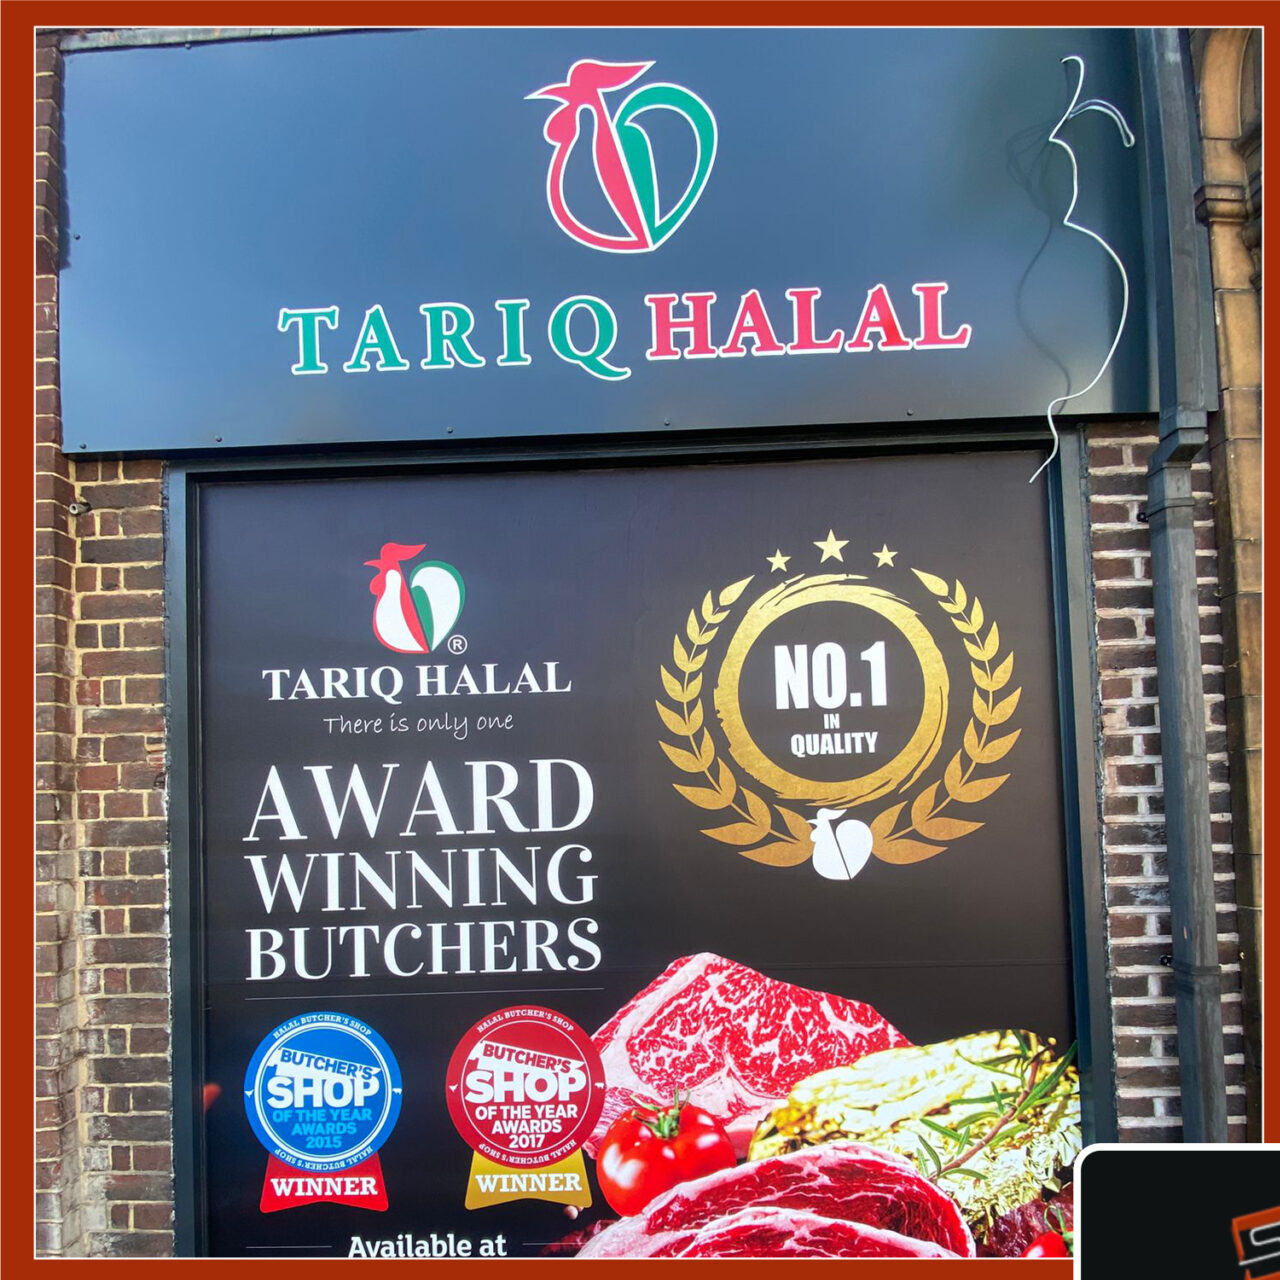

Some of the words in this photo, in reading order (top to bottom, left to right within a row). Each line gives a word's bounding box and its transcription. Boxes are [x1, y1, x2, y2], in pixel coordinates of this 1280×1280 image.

[277, 294, 632, 382] TARIQ
[645, 282, 972, 360] HALAL
[262, 665, 405, 705] TARIQ
[415, 661, 572, 697] HALAL
[774, 641, 888, 710] NO.1
[323, 714, 384, 735] There
[389, 713, 410, 733] is
[416, 712, 469, 740] only
[476, 713, 514, 732] one
[823, 713, 840, 730] IN
[790, 730, 879, 758] QUALITY
[242, 758, 595, 842] AWARD
[244, 843, 599, 915] WINNING
[245, 916, 603, 982] BUTCHERS
[273, 1020, 300, 1040] HALAL
[301, 1014, 350, 1025] BUTCHER'S
[350, 1021, 373, 1037] SHOP
[477, 1014, 504, 1034] HALAL
[504, 1009, 552, 1020] BUTCHER'S
[552, 1015, 575, 1032] SHOP
[280, 1049, 374, 1081] BUTCHER'S
[482, 1043, 573, 1074] BUTCHER'S
[267, 1075, 381, 1109] SHOP
[465, 1068, 587, 1104] SHOP
[272, 1110, 293, 1123] OF
[294, 1109, 327, 1122] THE
[329, 1107, 373, 1122] YEAR
[475, 1106, 497, 1121] OF
[499, 1105, 533, 1119] THE
[534, 1104, 578, 1119] YEAR
[291, 1121, 358, 1136] AWARDS
[491, 1118, 563, 1134] AWARDS
[305, 1135, 343, 1150] 2015
[478, 1142, 501, 1160] SHOP
[508, 1133, 546, 1149] 2017
[551, 1138, 577, 1158] HALAL
[274, 1147, 297, 1165] SHOP
[298, 1158, 346, 1171] BUTCHER'S
[346, 1145, 374, 1166] HALAL
[502, 1152, 550, 1165] BUTCHER'S
[270, 1176, 379, 1197] WINNER
[475, 1173, 582, 1193] WINNER
[348, 1232, 473, 1259] Available
[479, 1233, 507, 1258] at
